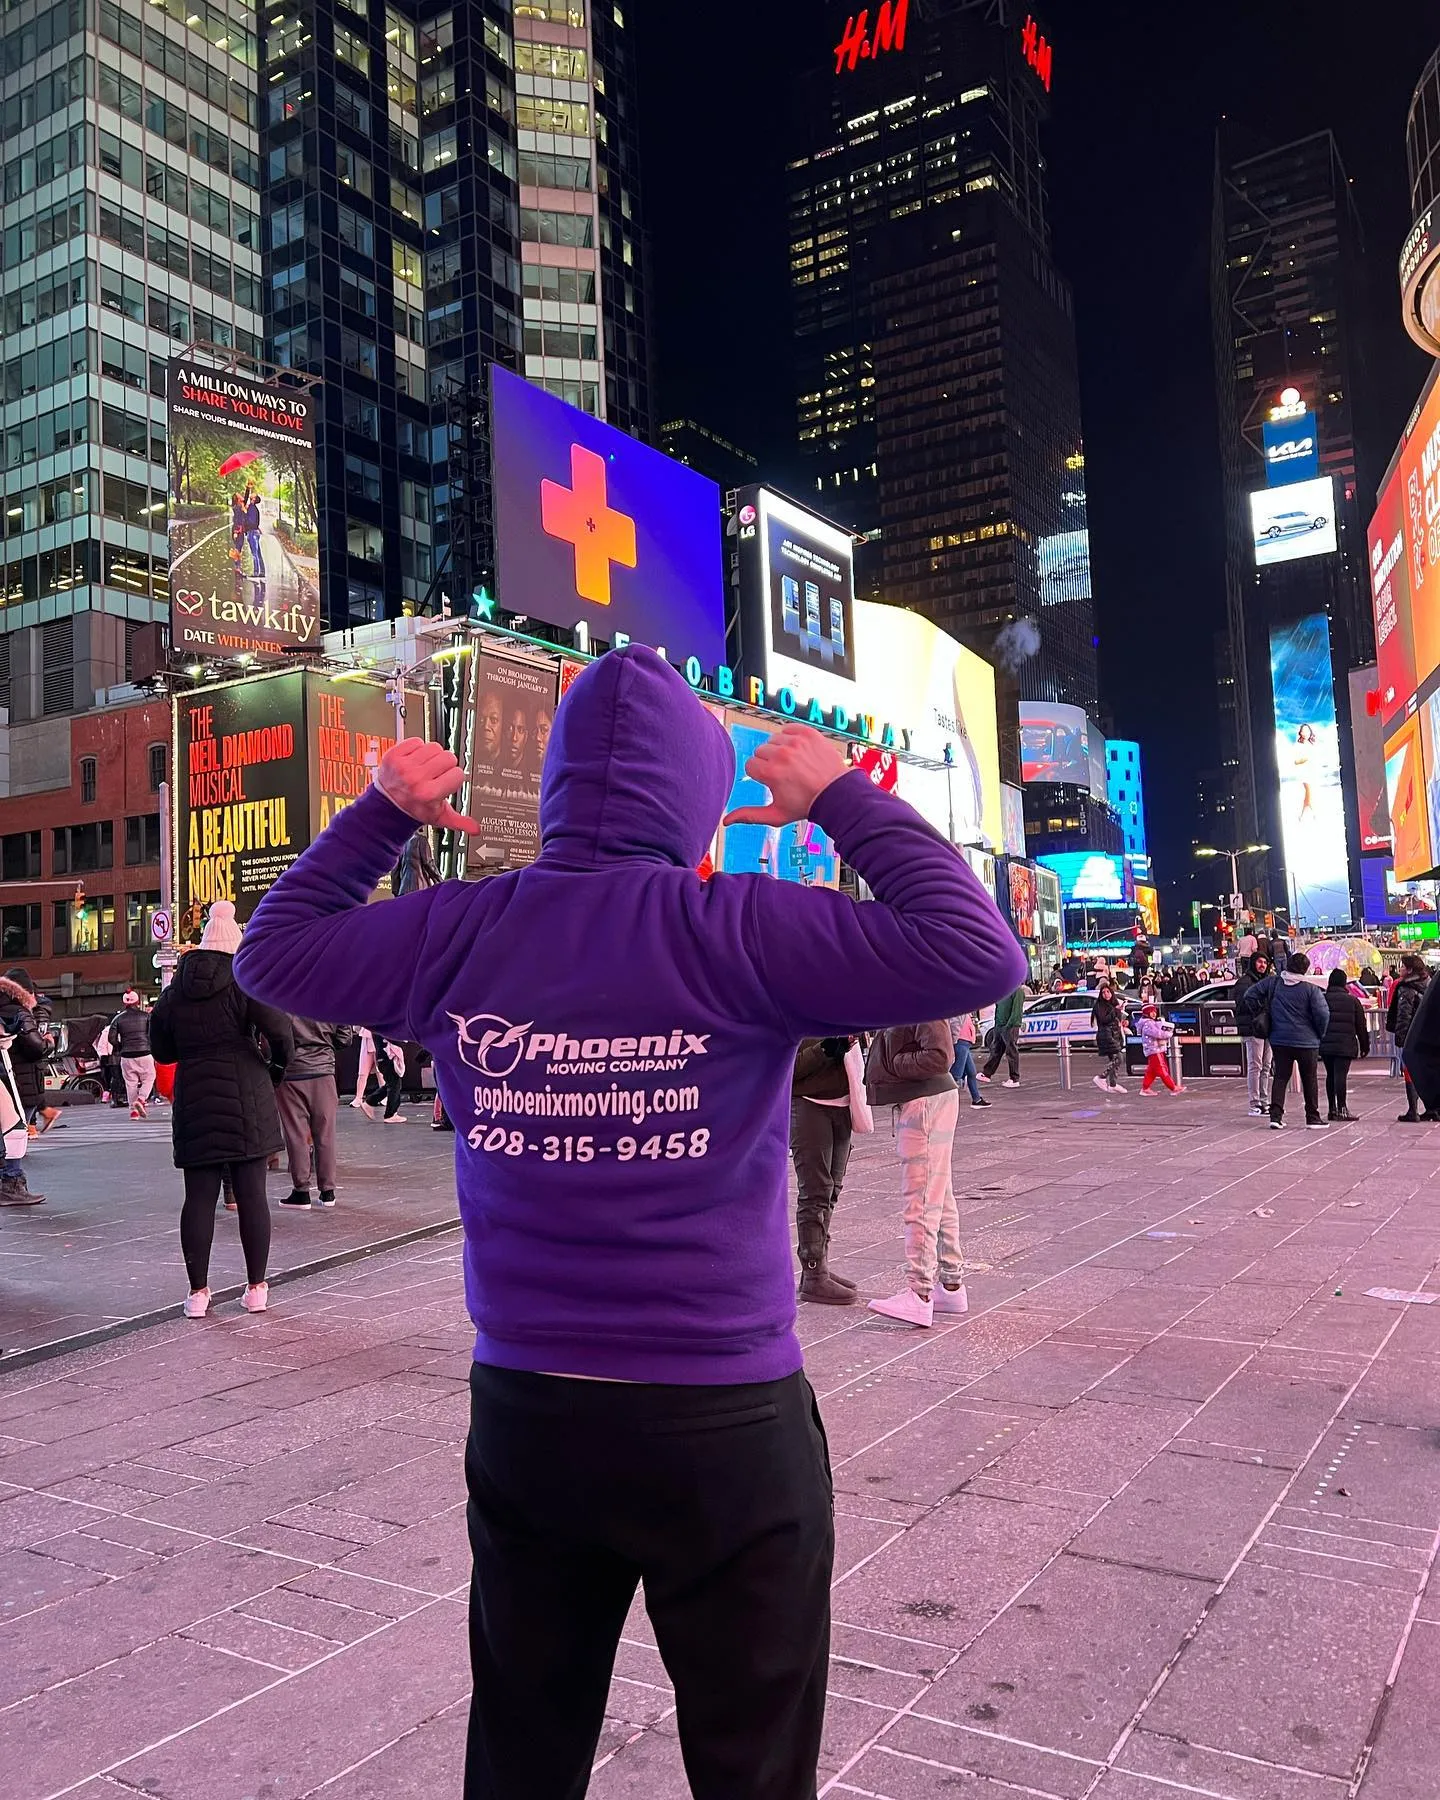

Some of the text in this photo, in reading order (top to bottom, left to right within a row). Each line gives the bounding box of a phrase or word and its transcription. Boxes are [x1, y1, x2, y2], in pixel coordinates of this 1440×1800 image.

[834, 0, 909, 74] H&M
[178, 369, 307, 417] A MILLION WAYS TO
[183, 386, 304, 431] SHARE YOUR LOVE
[173, 405, 312, 449] SHARE YOURS #MILLIONWAYSTOLOVE
[740, 525, 756, 538] LG
[209, 590, 316, 642] tawkify
[184, 628, 215, 644] DATE
[218, 634, 249, 649] WITH
[497, 667, 508, 675] ON
[189, 705, 213, 741] THE
[318, 692, 345, 730] THE
[189, 724, 294, 775] NEIL DIAMOND
[319, 726, 354, 763] NEIL
[190, 767, 246, 808] MUSICAL
[189, 797, 291, 857] A BEAUTIFUL
[481, 817, 507, 829] AUGUST
[494, 825, 514, 836] PIANO
[515, 828, 538, 839] LESSON
[189, 854, 236, 906] NOISE
[524, 1029, 712, 1061] Phoenix
[1027, 1020, 1059, 1033] NYPD
[546, 1058, 688, 1075] MOVING COMPANY
[474, 1080, 699, 1125] gophoenixmoving.com
[467, 1124, 711, 1163] 508-315-9458
